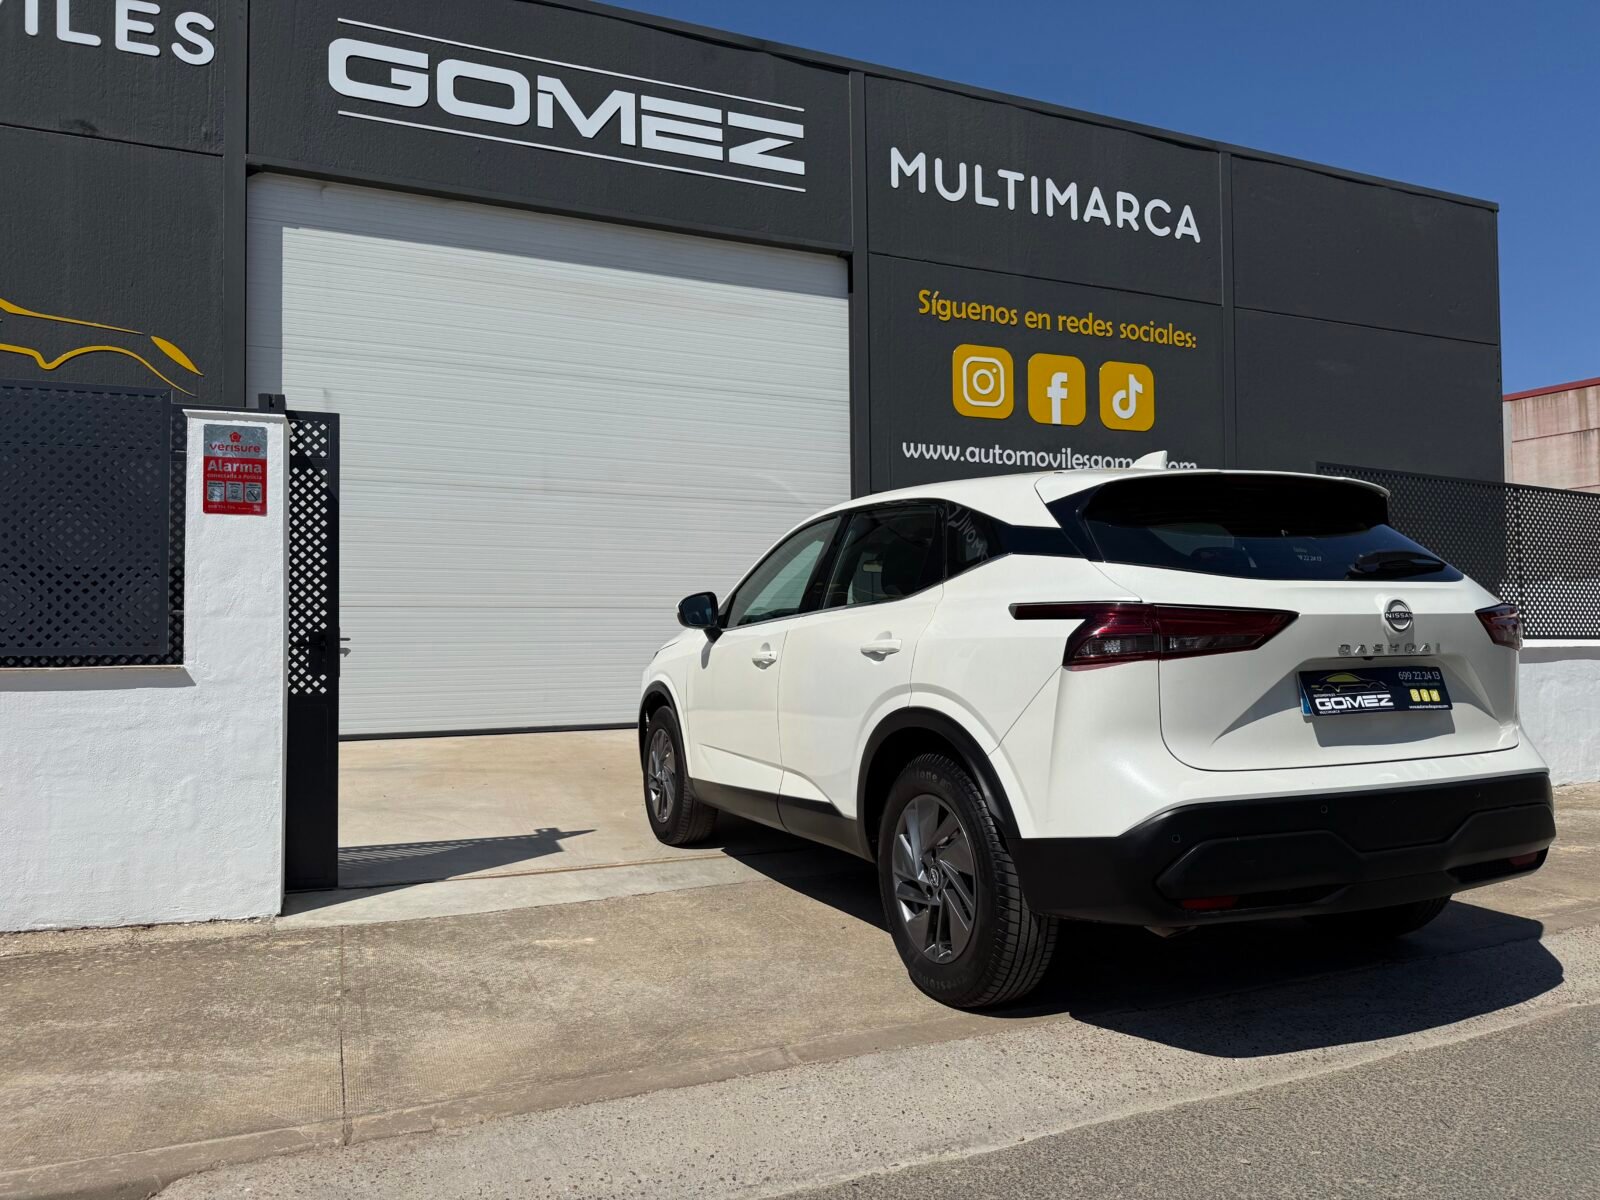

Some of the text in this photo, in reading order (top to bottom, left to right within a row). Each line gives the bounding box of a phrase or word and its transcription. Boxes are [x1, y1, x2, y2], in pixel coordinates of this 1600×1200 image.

[0, 0, 215, 66] ILES
[328, 37, 806, 175] GOMEZ
[890, 146, 1201, 243] MULTIMARCA
[918, 289, 1198, 349] Síguenos en redes sociales:
[209, 443, 261, 453] verisure
[208, 459, 262, 474] Alarma
[1385, 611, 1413, 620] NISSAN
[1398, 671, 1441, 680] 699 22 24 13
[1315, 694, 1394, 711] GOMEZ
